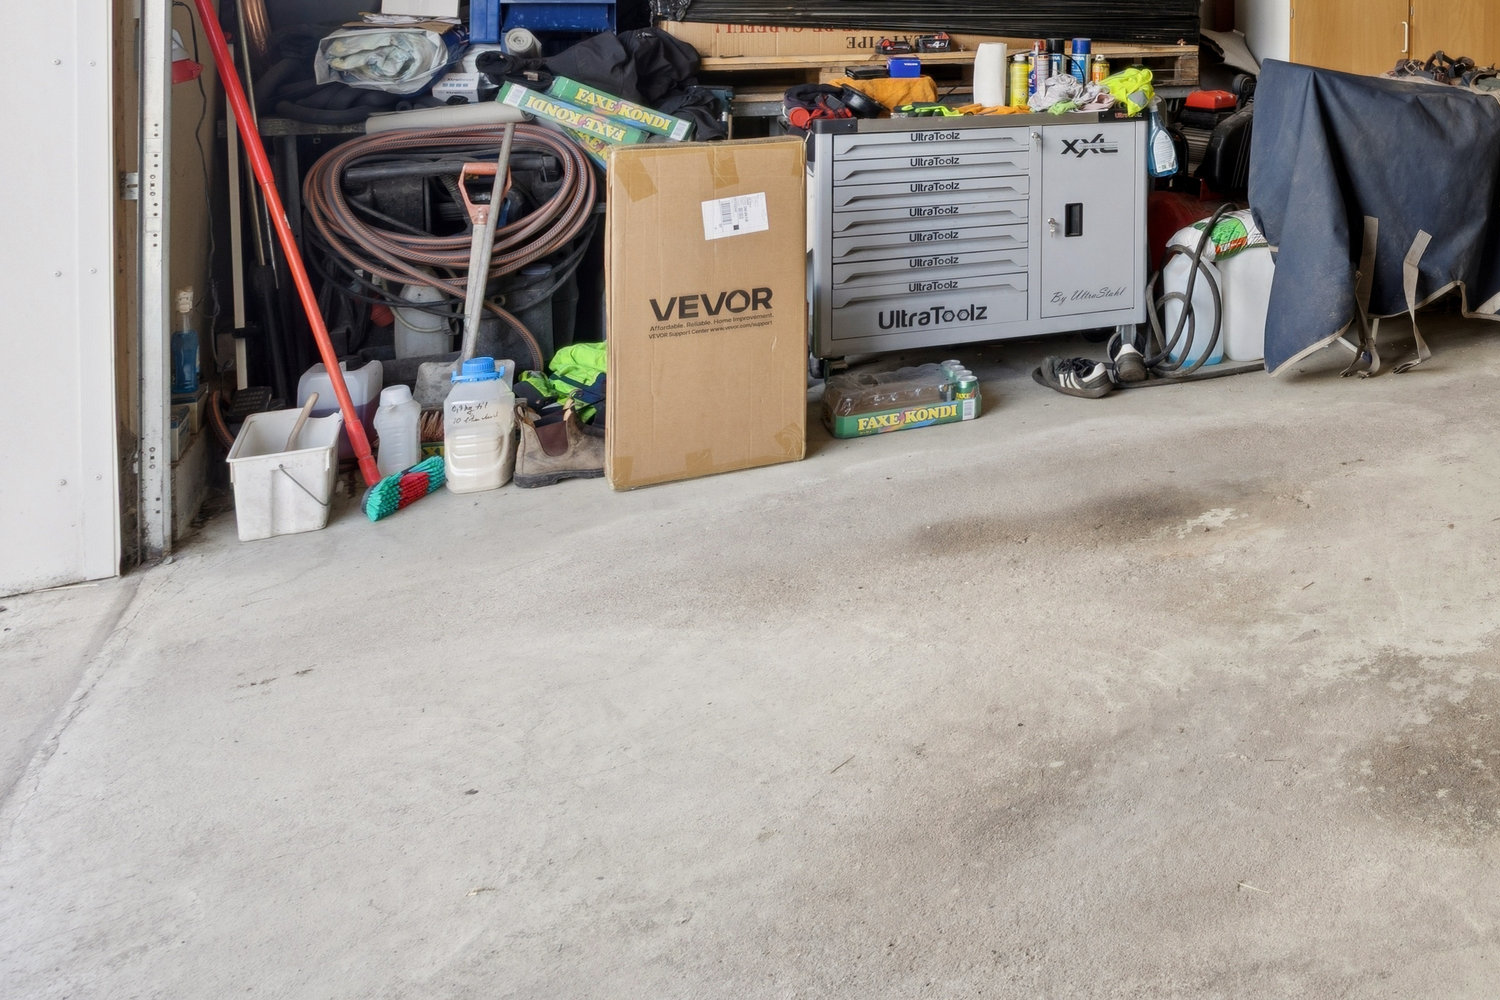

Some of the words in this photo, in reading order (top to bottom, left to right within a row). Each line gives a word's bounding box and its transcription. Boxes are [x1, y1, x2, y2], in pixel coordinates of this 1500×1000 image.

[525, 95, 580, 126] KONDI
[576, 87, 617, 113] FAXE
[617, 103, 673, 132] KONDI
[583, 116, 627, 142] FAXE
[910, 131, 961, 143] UltraToolz
[1060, 133, 1119, 159] XXL
[910, 156, 960, 167] UltraToolz
[910, 181, 960, 193] UltraToolz
[909, 205, 959, 218] UltraToolz
[909, 230, 959, 243] UltraToolz
[909, 255, 959, 269] UltraToolz
[908, 280, 958, 293] UltraToolz
[1049, 290, 1068, 305] By
[1070, 285, 1127, 302] UltraStahl
[648, 286, 774, 322] VEVOR
[649, 322, 686, 332] Affordable.
[686, 319, 713, 328] Reliable.
[713, 317, 732, 325] Home
[732, 312, 775, 322] Improvement.
[878, 303, 988, 331] UltraToolz
[648, 332, 669, 340] VEVOR
[669, 329, 691, 338] Support
[691, 327, 710, 335] Center
[857, 412, 901, 432] FAXE
[903, 403, 959, 424] KONDI
